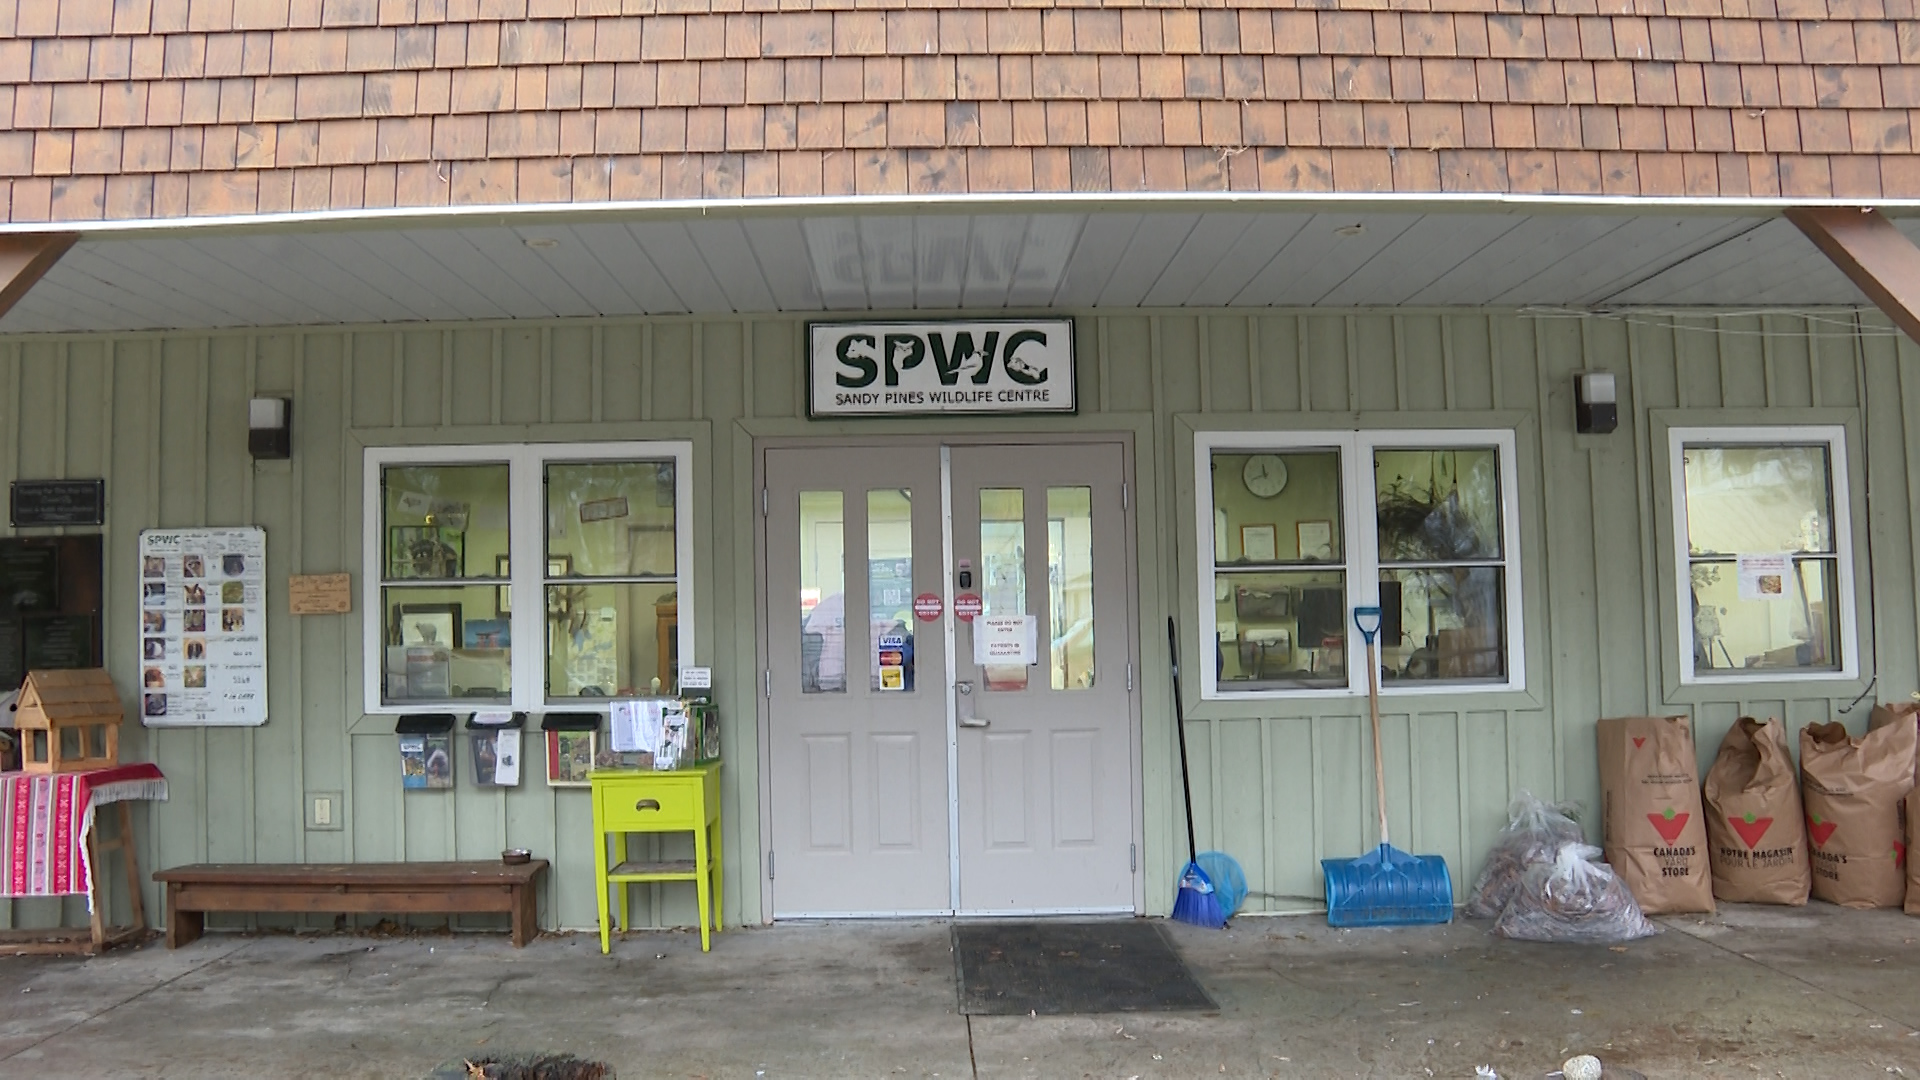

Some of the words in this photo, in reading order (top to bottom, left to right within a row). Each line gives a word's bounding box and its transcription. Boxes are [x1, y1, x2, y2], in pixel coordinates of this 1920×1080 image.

[835, 330, 1049, 388] SPWC
[835, 392, 880, 406] SANDY
[884, 391, 925, 404] PINES
[929, 390, 993, 404] WILDLIFE
[997, 389, 1050, 402] CENTRE
[147, 534, 181, 546] SPWC
[882, 637, 902, 645] VISA
[1653, 846, 1696, 858] CANADA'S
[1720, 847, 1749, 859] NOTRE
[1752, 846, 1793, 858] MAGASIN
[1662, 867, 1689, 877] STORE
